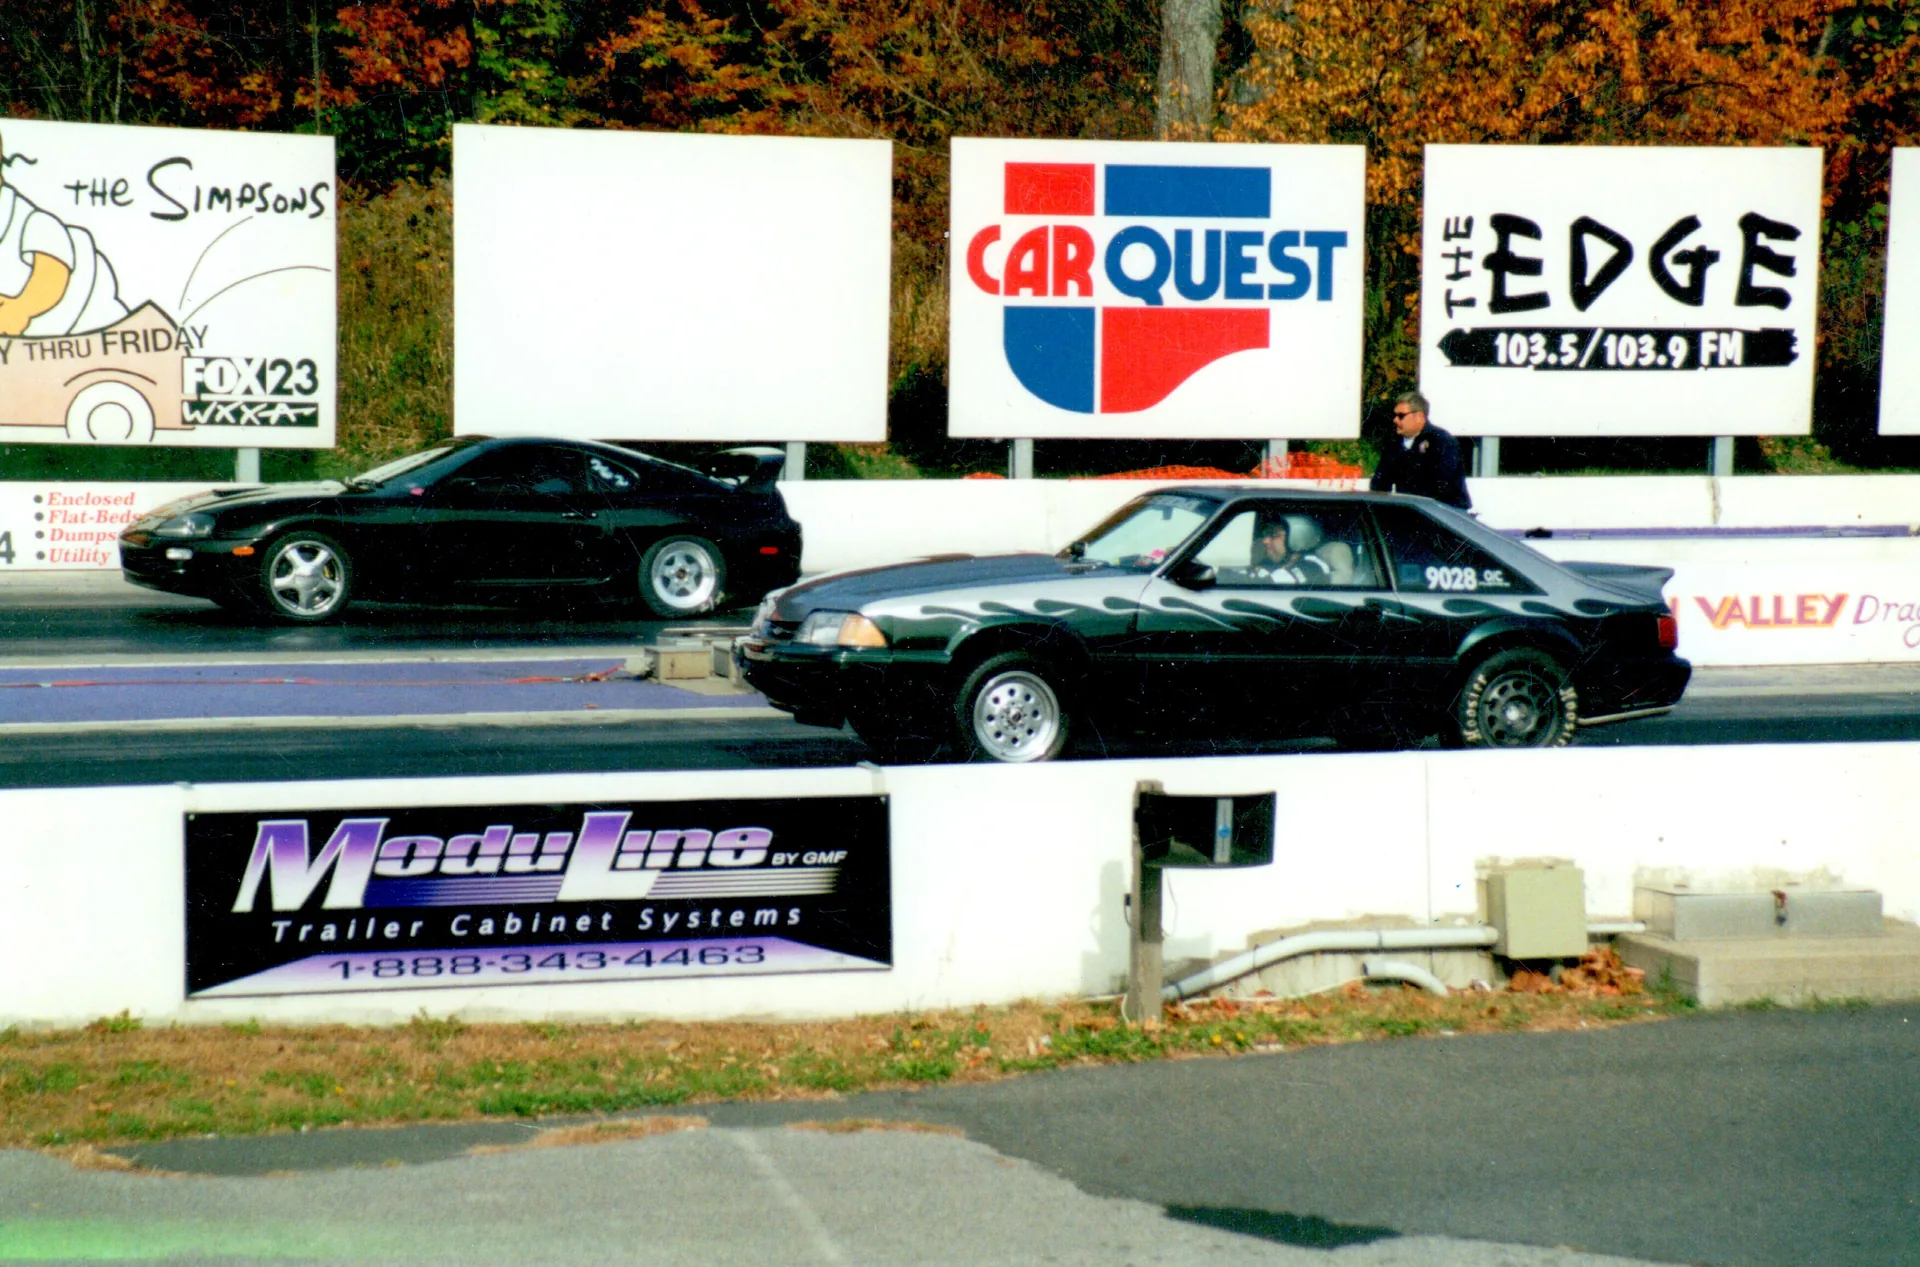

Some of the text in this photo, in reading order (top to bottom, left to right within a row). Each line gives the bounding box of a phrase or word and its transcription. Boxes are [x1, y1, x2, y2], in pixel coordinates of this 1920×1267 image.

[966, 224, 1348, 306] CARQUEST
[1443, 211, 1802, 319] THE EDGE
[22, 338, 92, 362] THRU
[101, 324, 208, 356] FRIDAY
[1494, 328, 1744, 369] 103.5/103.9 FM
[47, 492, 136, 506] Enclosed
[49, 528, 118, 545] Dumps
[49, 548, 112, 566] Utility
[1425, 566, 1478, 590] 9028
[1694, 593, 1849, 630] VALLEY
[230, 811, 849, 913] ModuLine BY GMF
[271, 907, 802, 943] Trailer Cabinet Systems
[328, 944, 766, 980] 1-888-343-4463
